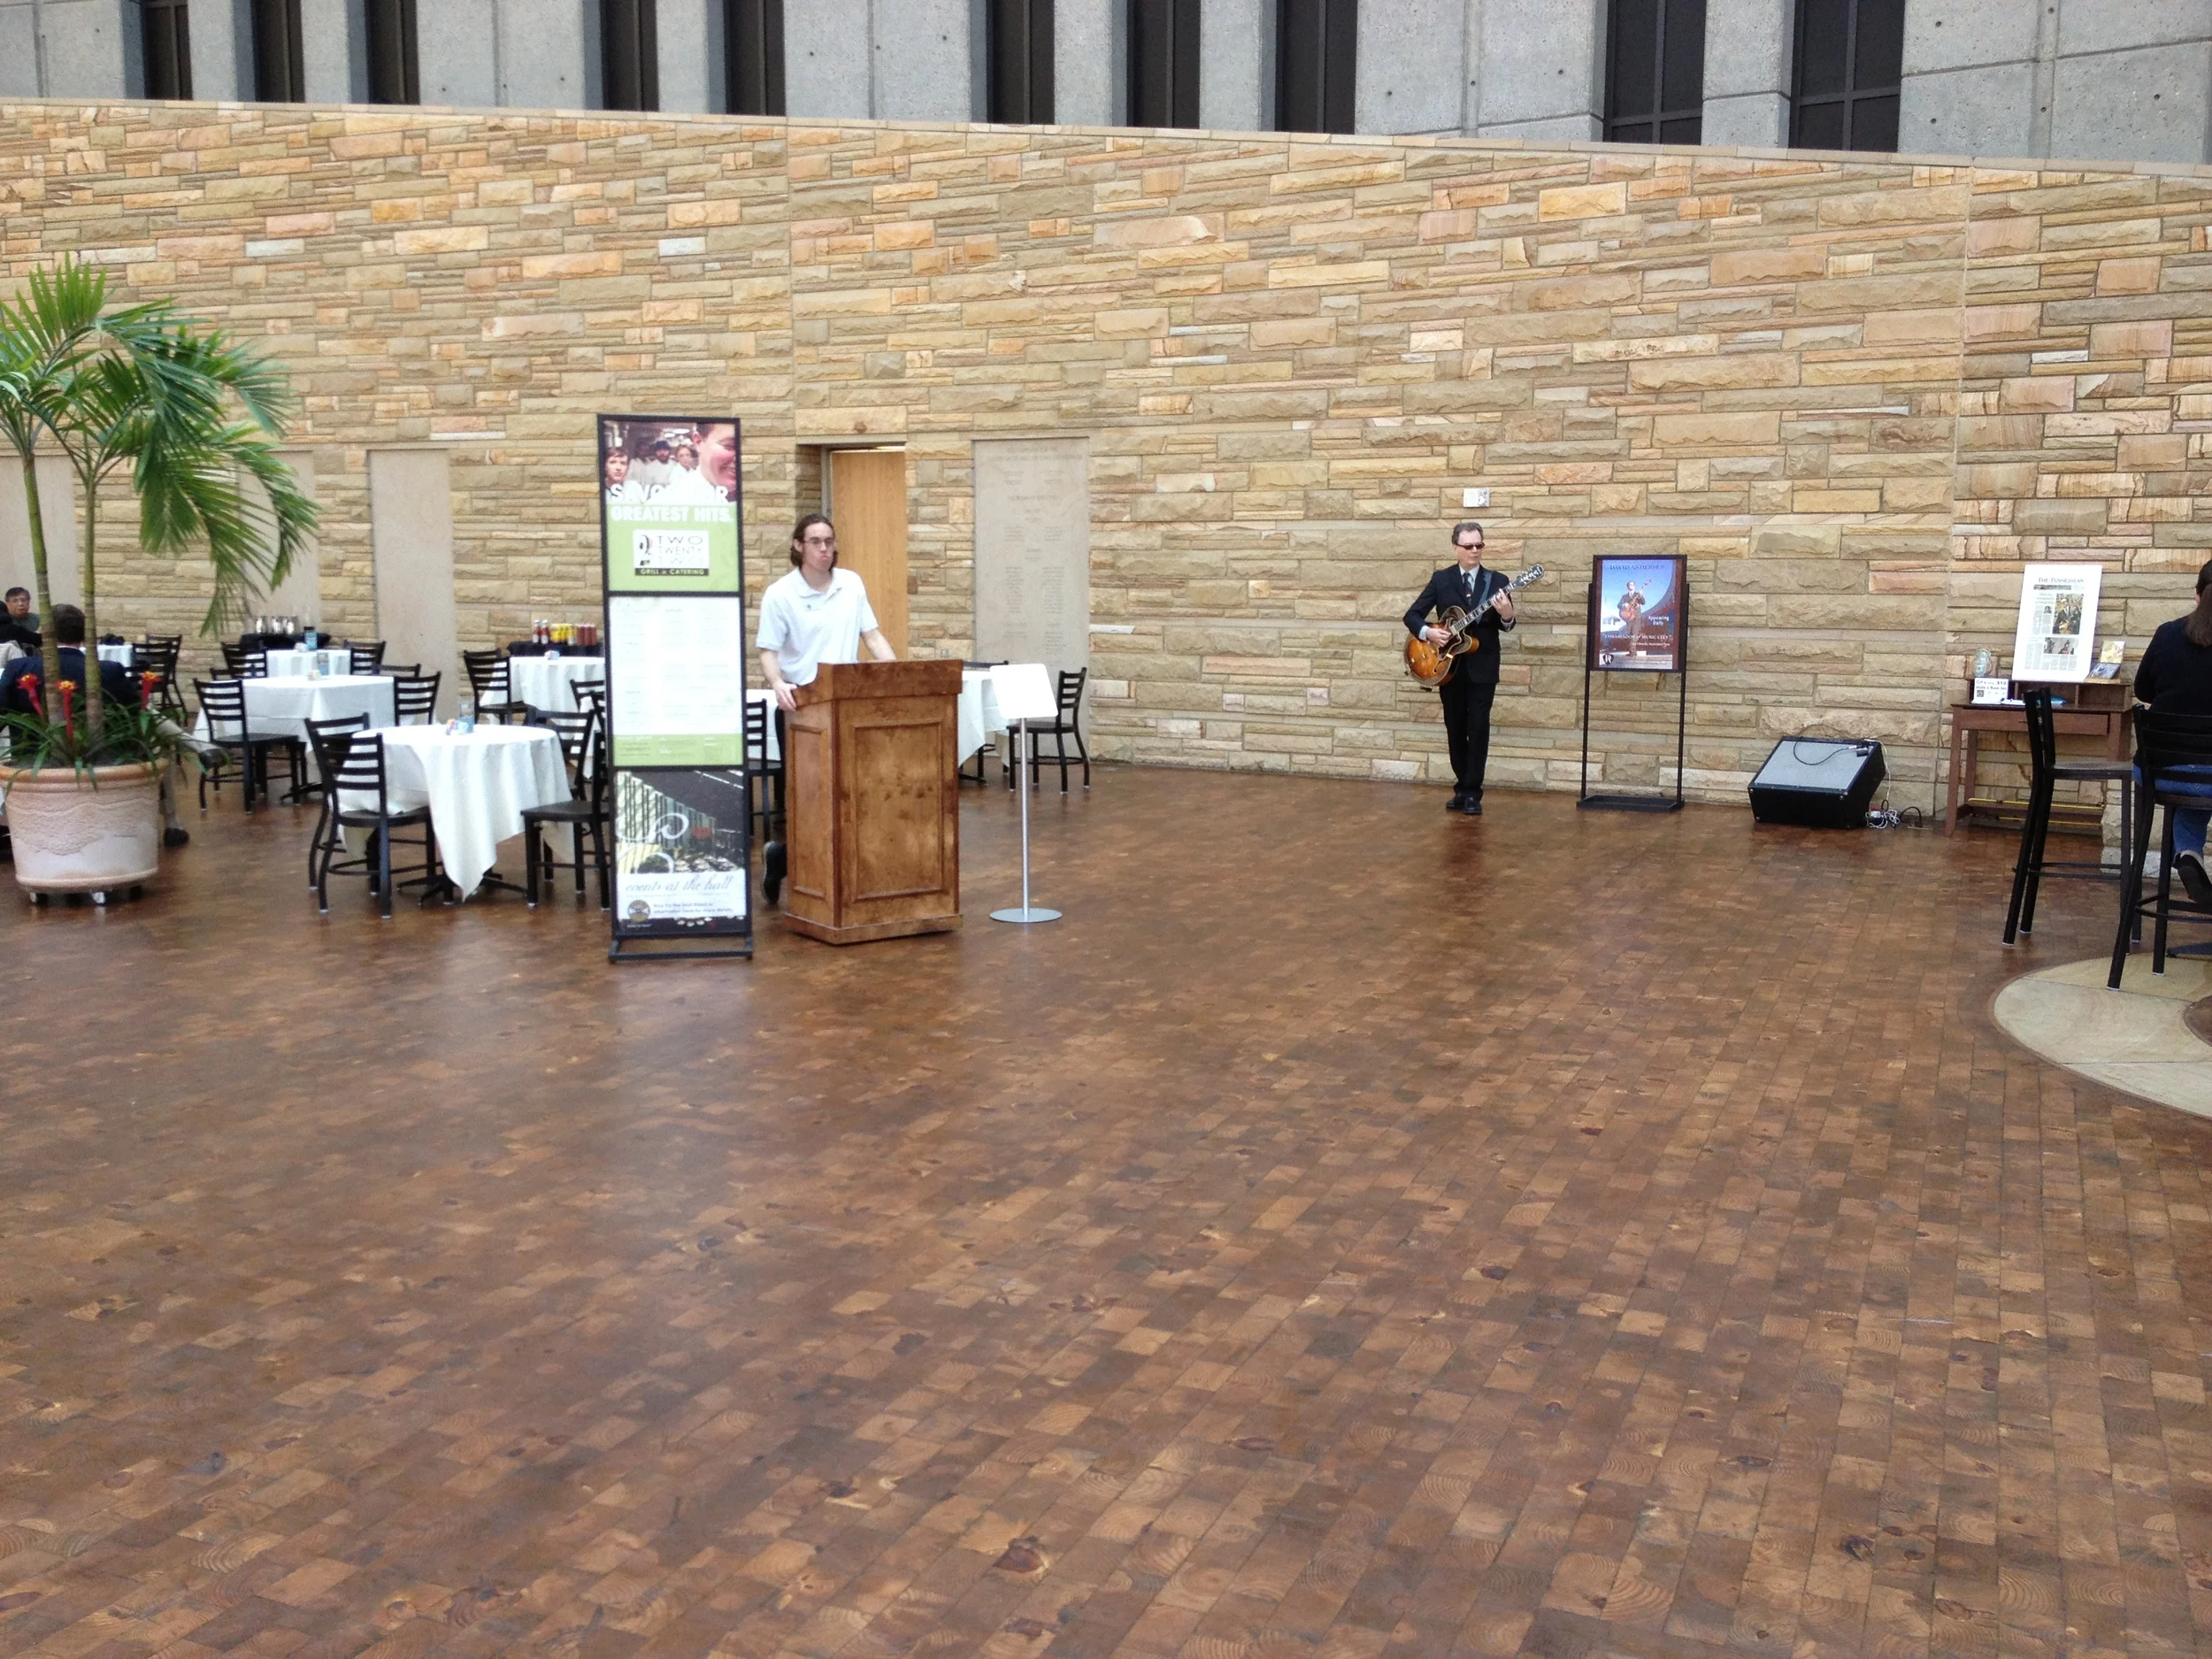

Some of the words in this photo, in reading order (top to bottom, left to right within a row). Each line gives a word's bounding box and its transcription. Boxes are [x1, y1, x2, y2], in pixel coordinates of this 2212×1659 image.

[611, 505, 689, 522] GREATEST
[657, 535, 703, 545] TWO
[658, 546, 702, 556] TWENTY
[704, 874, 733, 890] hall
